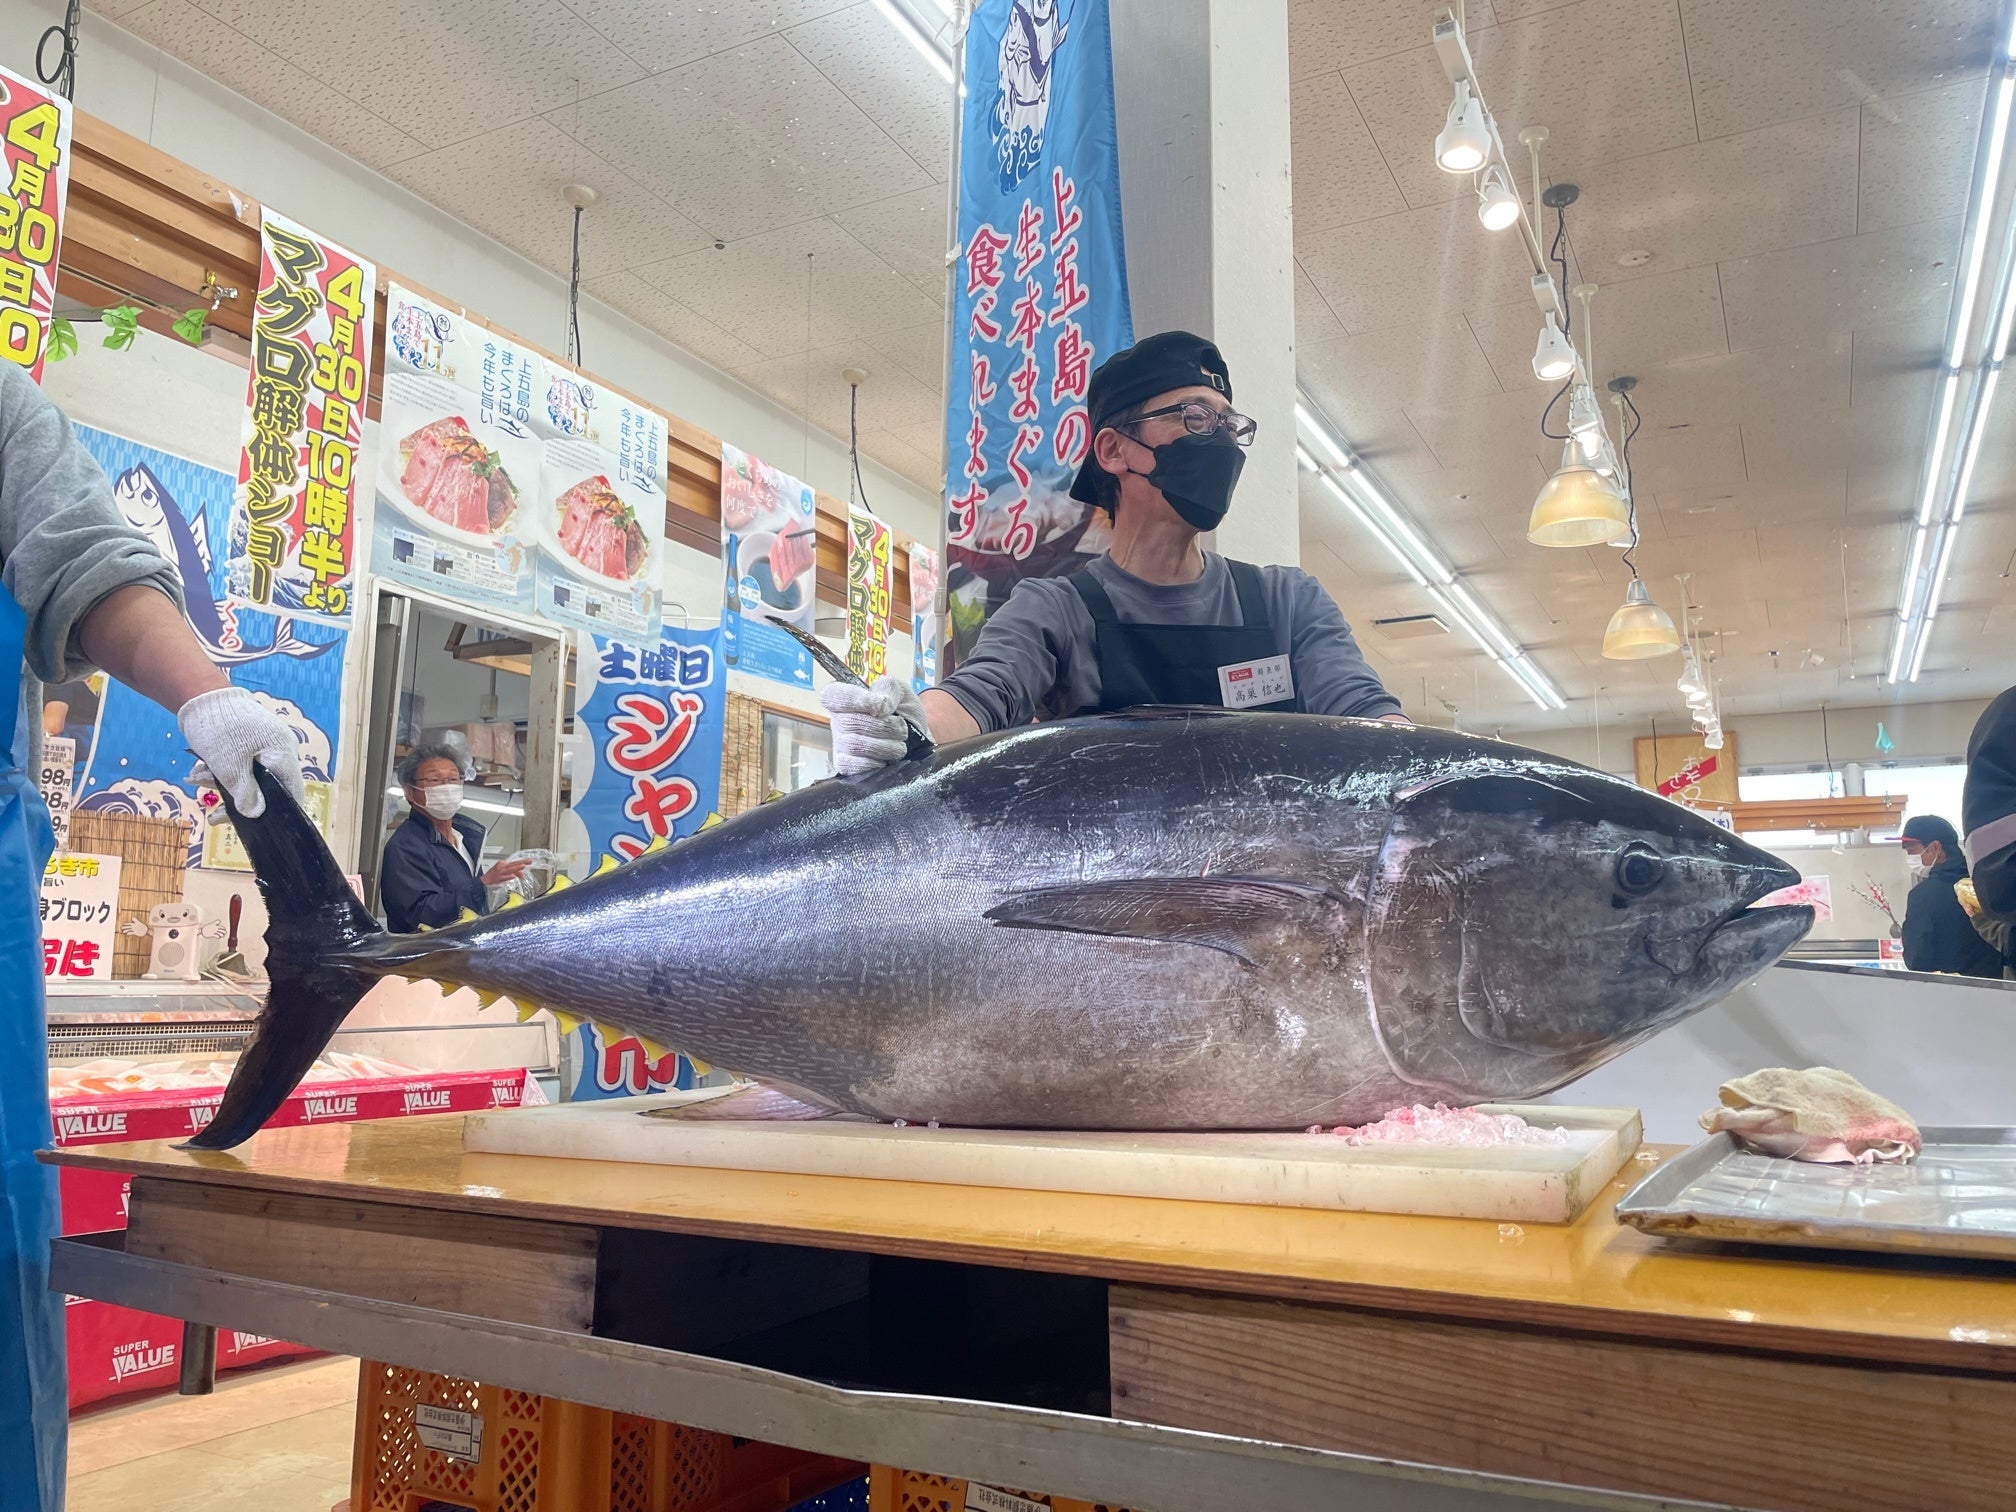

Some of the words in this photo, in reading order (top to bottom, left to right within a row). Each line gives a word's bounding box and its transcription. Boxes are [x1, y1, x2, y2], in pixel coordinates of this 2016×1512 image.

[1051, 171, 1093, 464] 上五島の
[480, 342, 496, 424] 今年も旨い
[516, 358, 532, 423] 上五島の
[950, 228, 1010, 541] 食べれます
[1003, 203, 1045, 556] 生本まぐろ
[245, 221, 321, 604] マグロ解体ショー
[299, 264, 366, 616] 4月30日10時半より
[646, 421, 659, 480] 上五島の
[848, 513, 876, 676] マグロ解体
[600, 642, 709, 686] 土曜日
[42, 938, 100, 977] 引き
[304, 1090, 338, 1099] SUPER
[403, 1090, 451, 1115] VALUE
[404, 1082, 433, 1092] SUPER
[491, 1087, 524, 1107] VALU
[492, 1079, 517, 1087] SUPER
[56, 1113, 127, 1144] VALUE
[303, 1096, 358, 1124] VALUE
[112, 1344, 175, 1384] VALUE
[113, 1340, 150, 1356] SUPER
